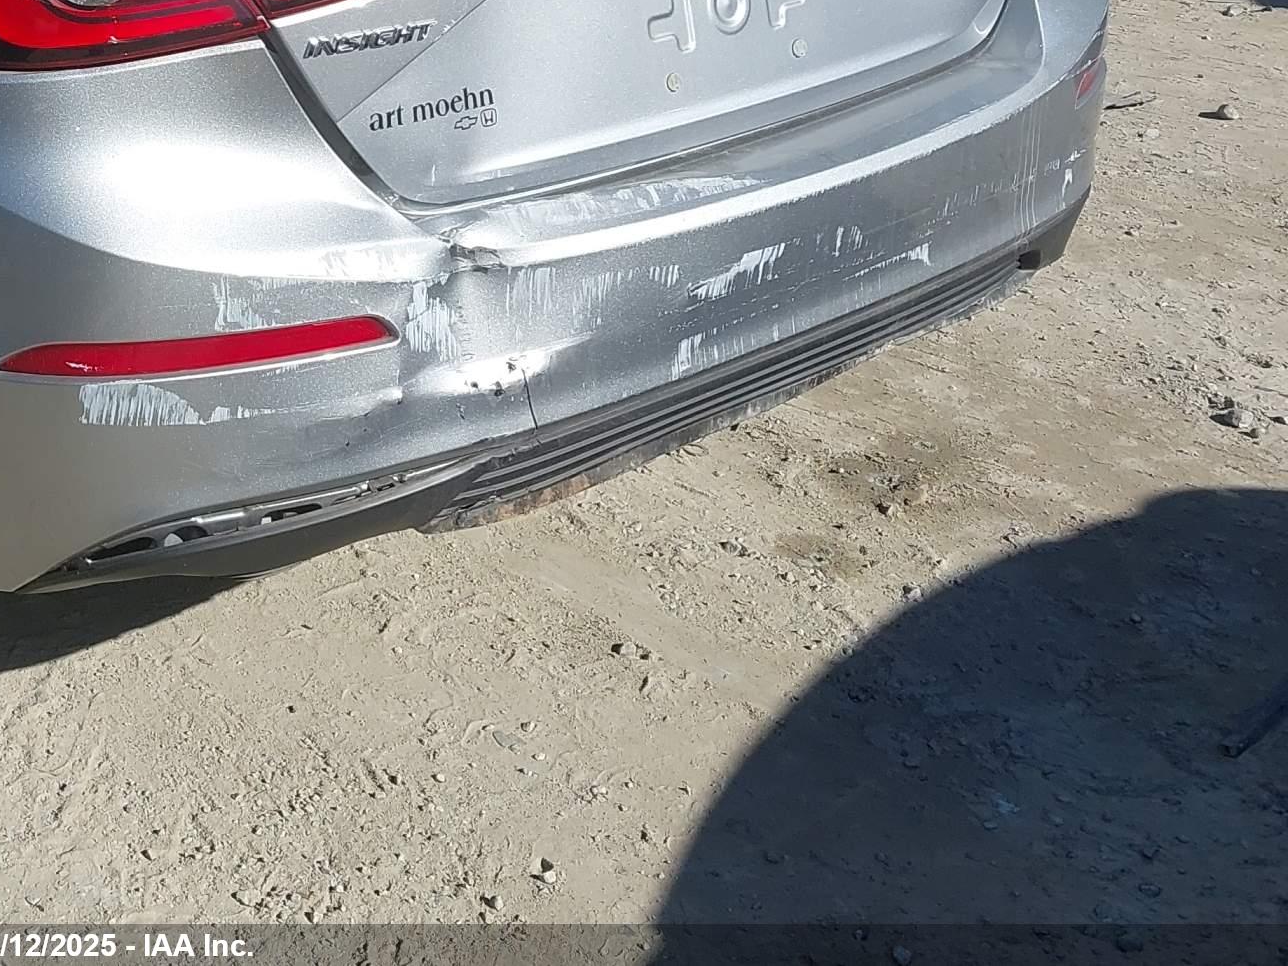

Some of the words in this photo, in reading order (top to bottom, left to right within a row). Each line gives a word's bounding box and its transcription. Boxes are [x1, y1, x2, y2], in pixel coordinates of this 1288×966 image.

[303, 18, 439, 60] INSIGHT
[369, 103, 404, 132] art
[412, 87, 495, 124] moehn
